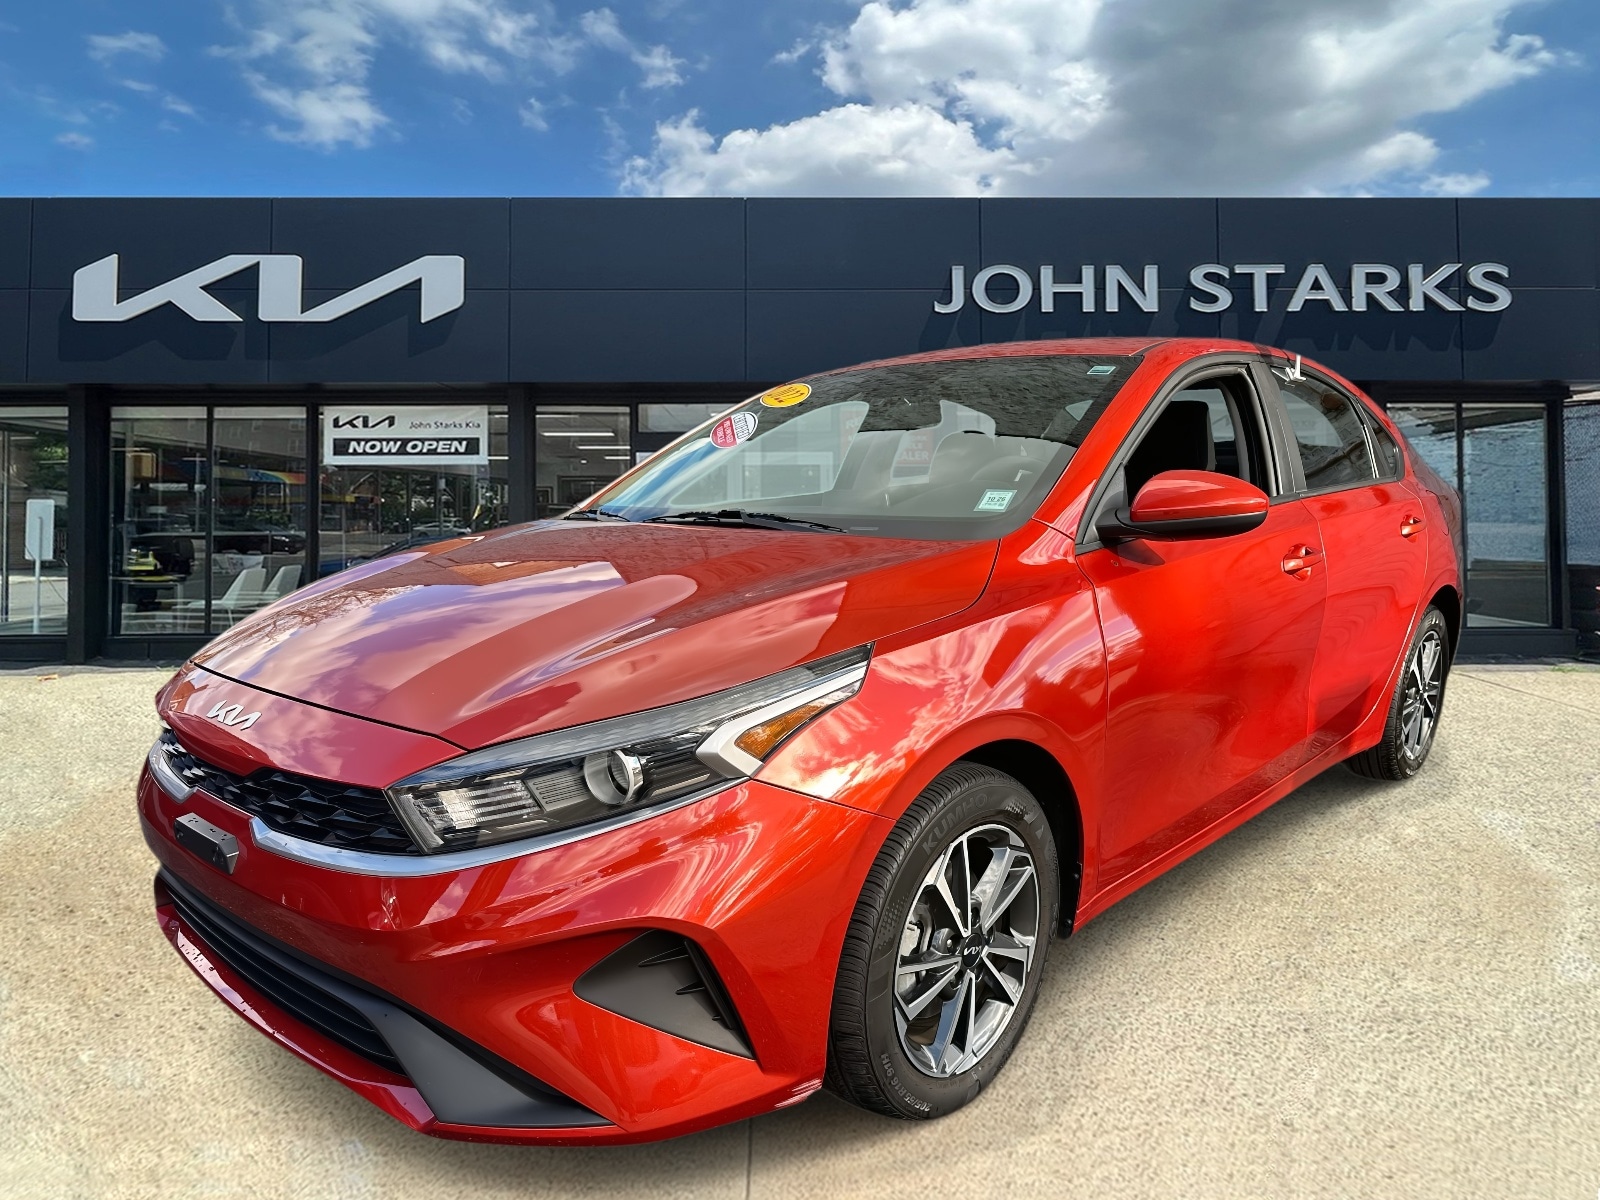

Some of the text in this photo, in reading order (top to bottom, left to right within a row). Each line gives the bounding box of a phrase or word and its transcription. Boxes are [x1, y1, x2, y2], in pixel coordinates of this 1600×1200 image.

[72, 253, 465, 324] KIA
[933, 263, 1513, 313] JOHN STARKS
[332, 415, 396, 429] KIA
[408, 421, 481, 430] John Starks Kia
[347, 440, 468, 453] NOW OPEN
[206, 700, 262, 731] KIA
[921, 793, 988, 856] KUMHO
